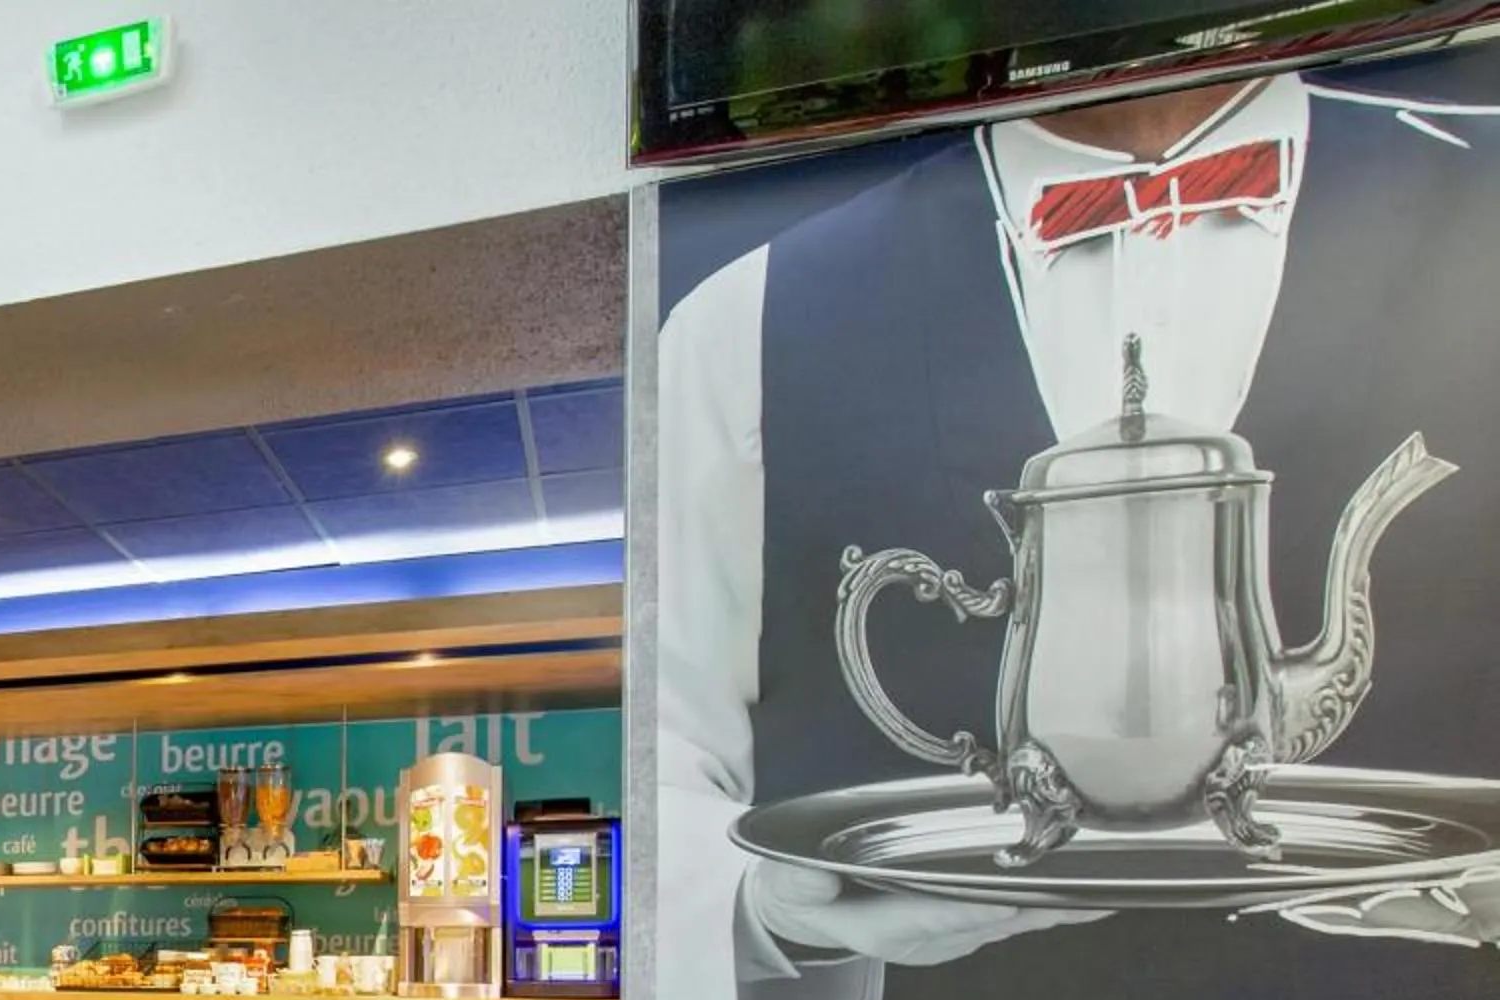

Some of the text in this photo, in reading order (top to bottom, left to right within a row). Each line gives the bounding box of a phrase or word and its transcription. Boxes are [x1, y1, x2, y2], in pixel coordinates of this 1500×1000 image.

[1009, 61, 1070, 80] SAMSUNG
[161, 734, 284, 774] beurre
[3, 834, 36, 854] café
[69, 910, 192, 938] confitures
